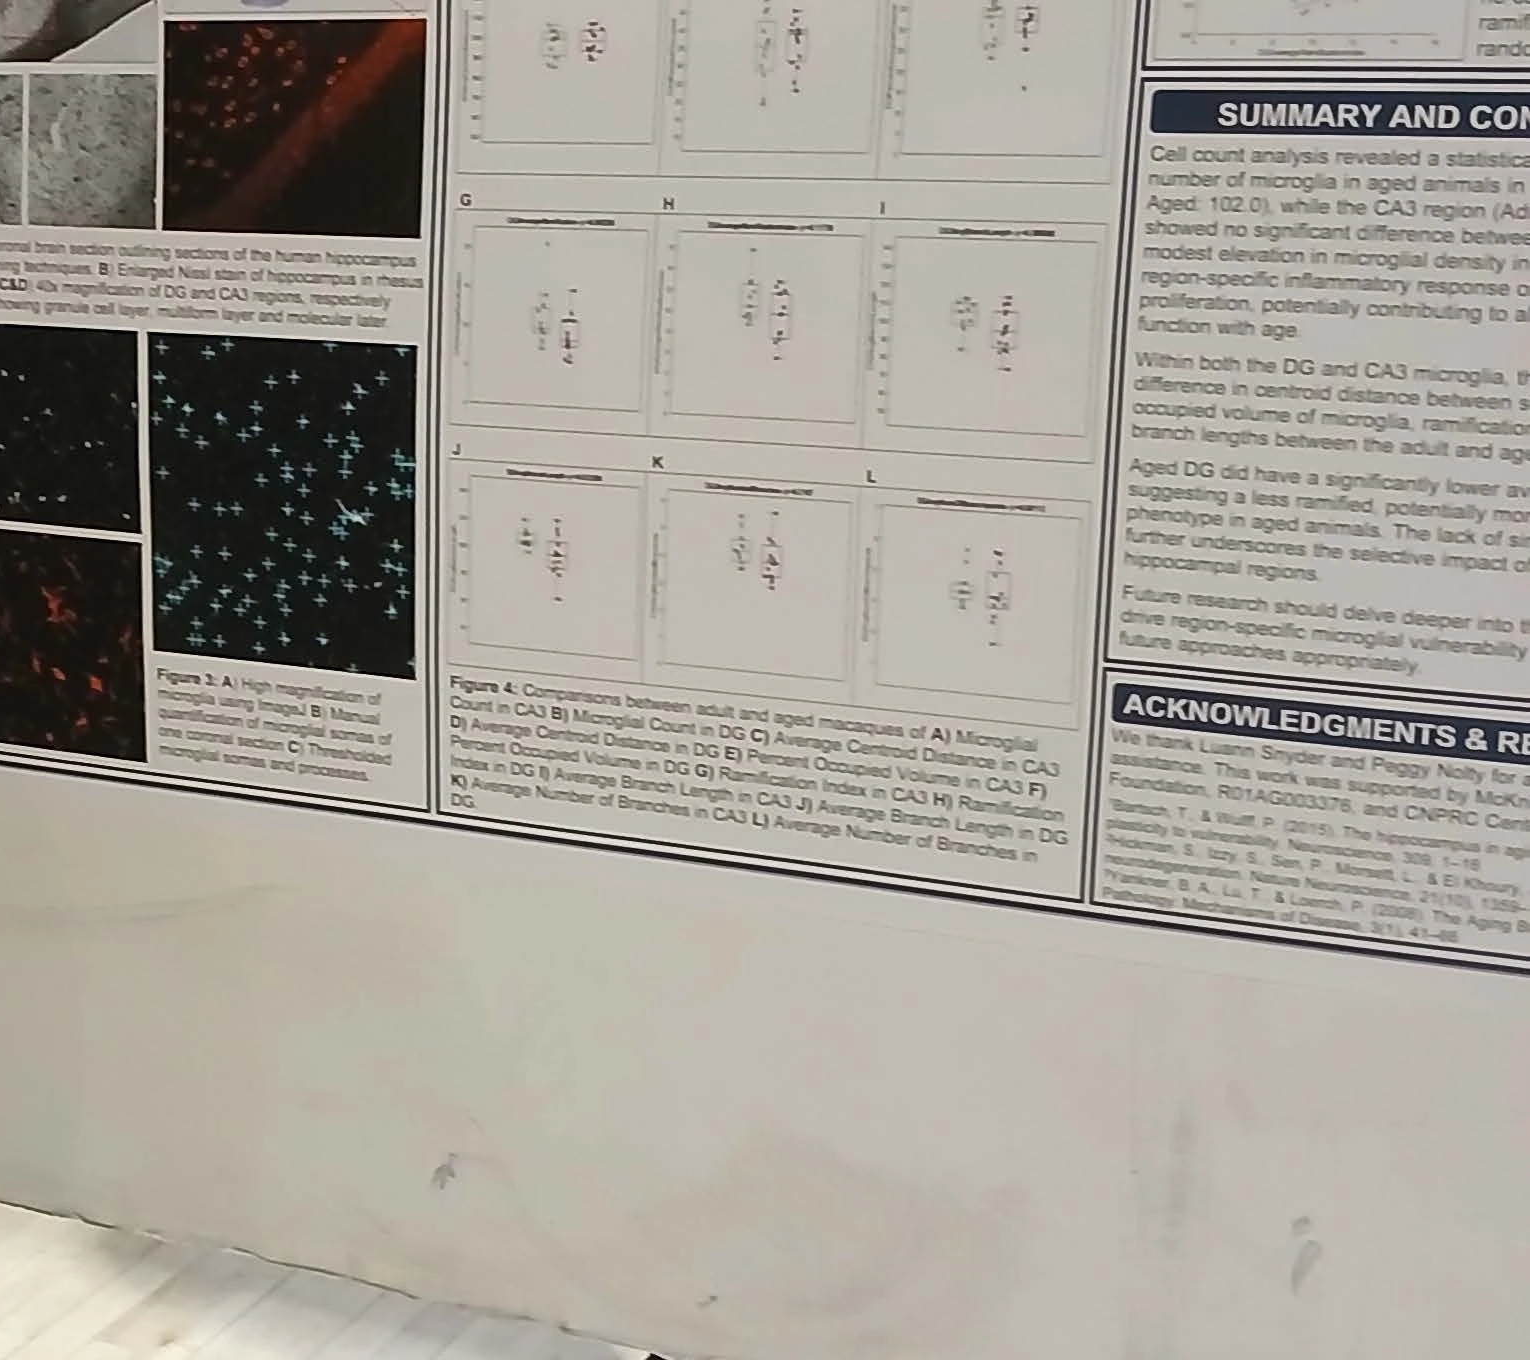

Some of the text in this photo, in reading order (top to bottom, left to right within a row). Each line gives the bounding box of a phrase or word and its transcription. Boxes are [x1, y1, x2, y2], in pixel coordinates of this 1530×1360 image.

[1218, 103, 1381, 127] SUMMARY
[1389, 105, 1459, 129] AND
[1150, 145, 1438, 168] Cell count analysis revealed a
[1148, 172, 1525, 195] number of microglia in aged animals in
[460, 194, 471, 207] G
[663, 198, 674, 211] H
[1281, 198, 1485, 220] while the CA3 region
[1145, 221, 1454, 243] showed no significant difference
[1143, 246, 1505, 273] modest elevation in microglial density
[1141, 269, 1510, 297] region-specific inflammatory response
[1199, 355, 1241, 372] both
[1246, 356, 1277, 373] the
[1283, 358, 1315, 375] DG
[1322, 360, 1357, 377] and
[1364, 361, 1407, 380] CA3
[1254, 384, 1512, 409] centroid distance between
[452, 444, 461, 456] J
[653, 456, 664, 469] K
[867, 470, 876, 483] L
[1130, 458, 1500, 497] Aged DG did have a significantly lower
[1124, 552, 1242, 575] hippocampal
[1122, 585, 1513, 633] Future research should delve deeper into
[450, 675, 498, 693] Figure
[1123, 693, 1456, 748] ACKNOWLEDGMENTS
[1465, 727, 1488, 751] &
